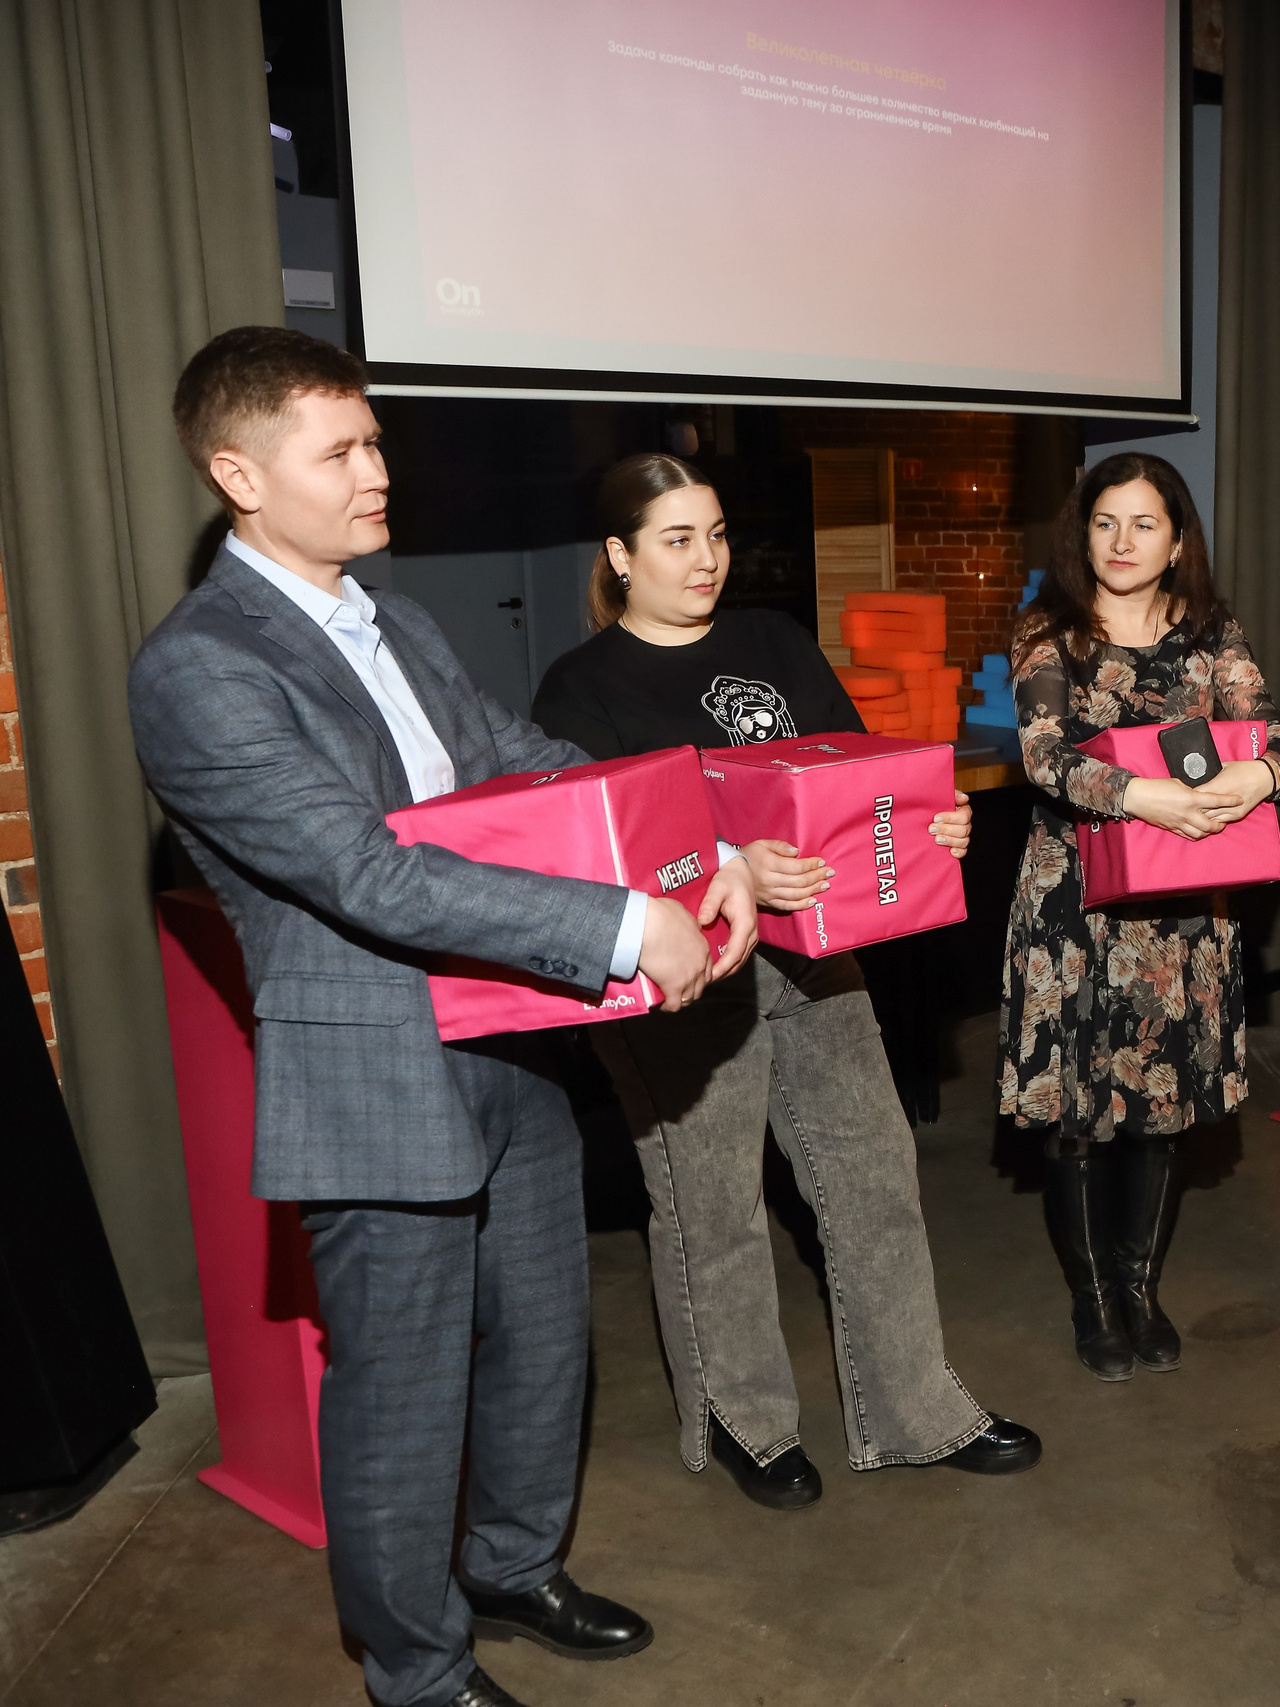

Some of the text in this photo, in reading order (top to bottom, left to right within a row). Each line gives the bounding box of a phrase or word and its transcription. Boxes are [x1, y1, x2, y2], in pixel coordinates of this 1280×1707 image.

[746, 32, 870, 74] Великолепная
[607, 40, 1050, 141] Задача команды собрать как можно большее количество верных комбинаций на
[740, 84, 952, 135] заданную тему за ограниченное время
[436, 277, 481, 306] On
[655, 850, 704, 894] МЕНЯЕТ
[873, 794, 898, 905] ПРОЛЕТАЯ
[814, 902, 829, 949] EventyOn
